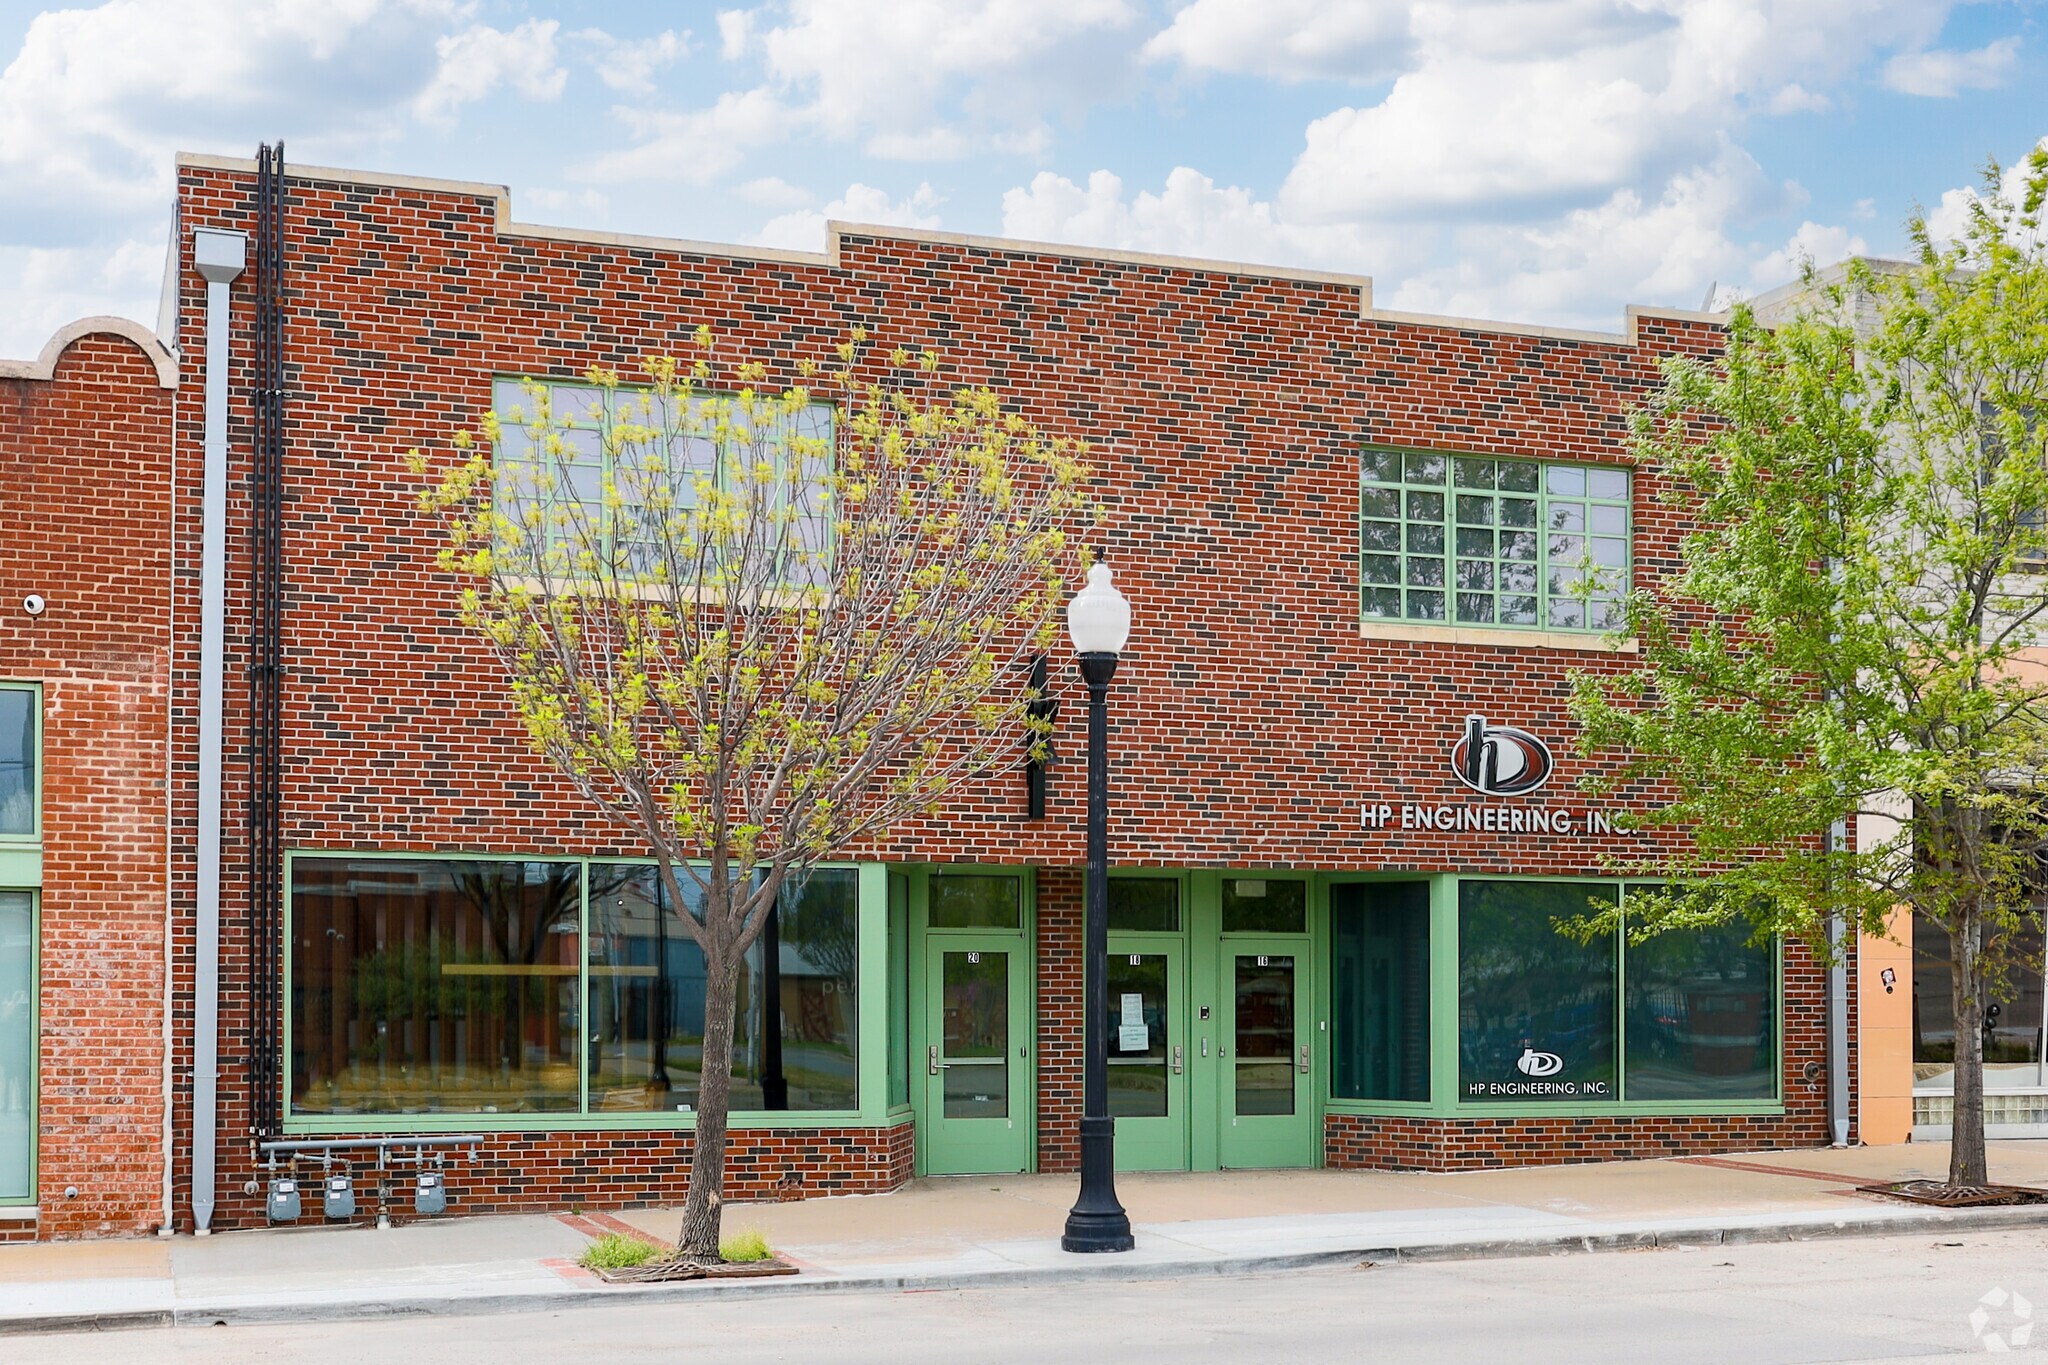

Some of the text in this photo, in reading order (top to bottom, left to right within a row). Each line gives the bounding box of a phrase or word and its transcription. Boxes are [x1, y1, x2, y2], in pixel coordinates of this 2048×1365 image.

[1360, 804, 1392, 828] HP
[1402, 806, 1578, 836] ENGINEERING,
[968, 952, 980, 963] 20
[1130, 954, 1141, 965] 18
[1257, 956, 1268, 966] 16
[1469, 1082, 1610, 1095] HP ENGINEERING, INC.
